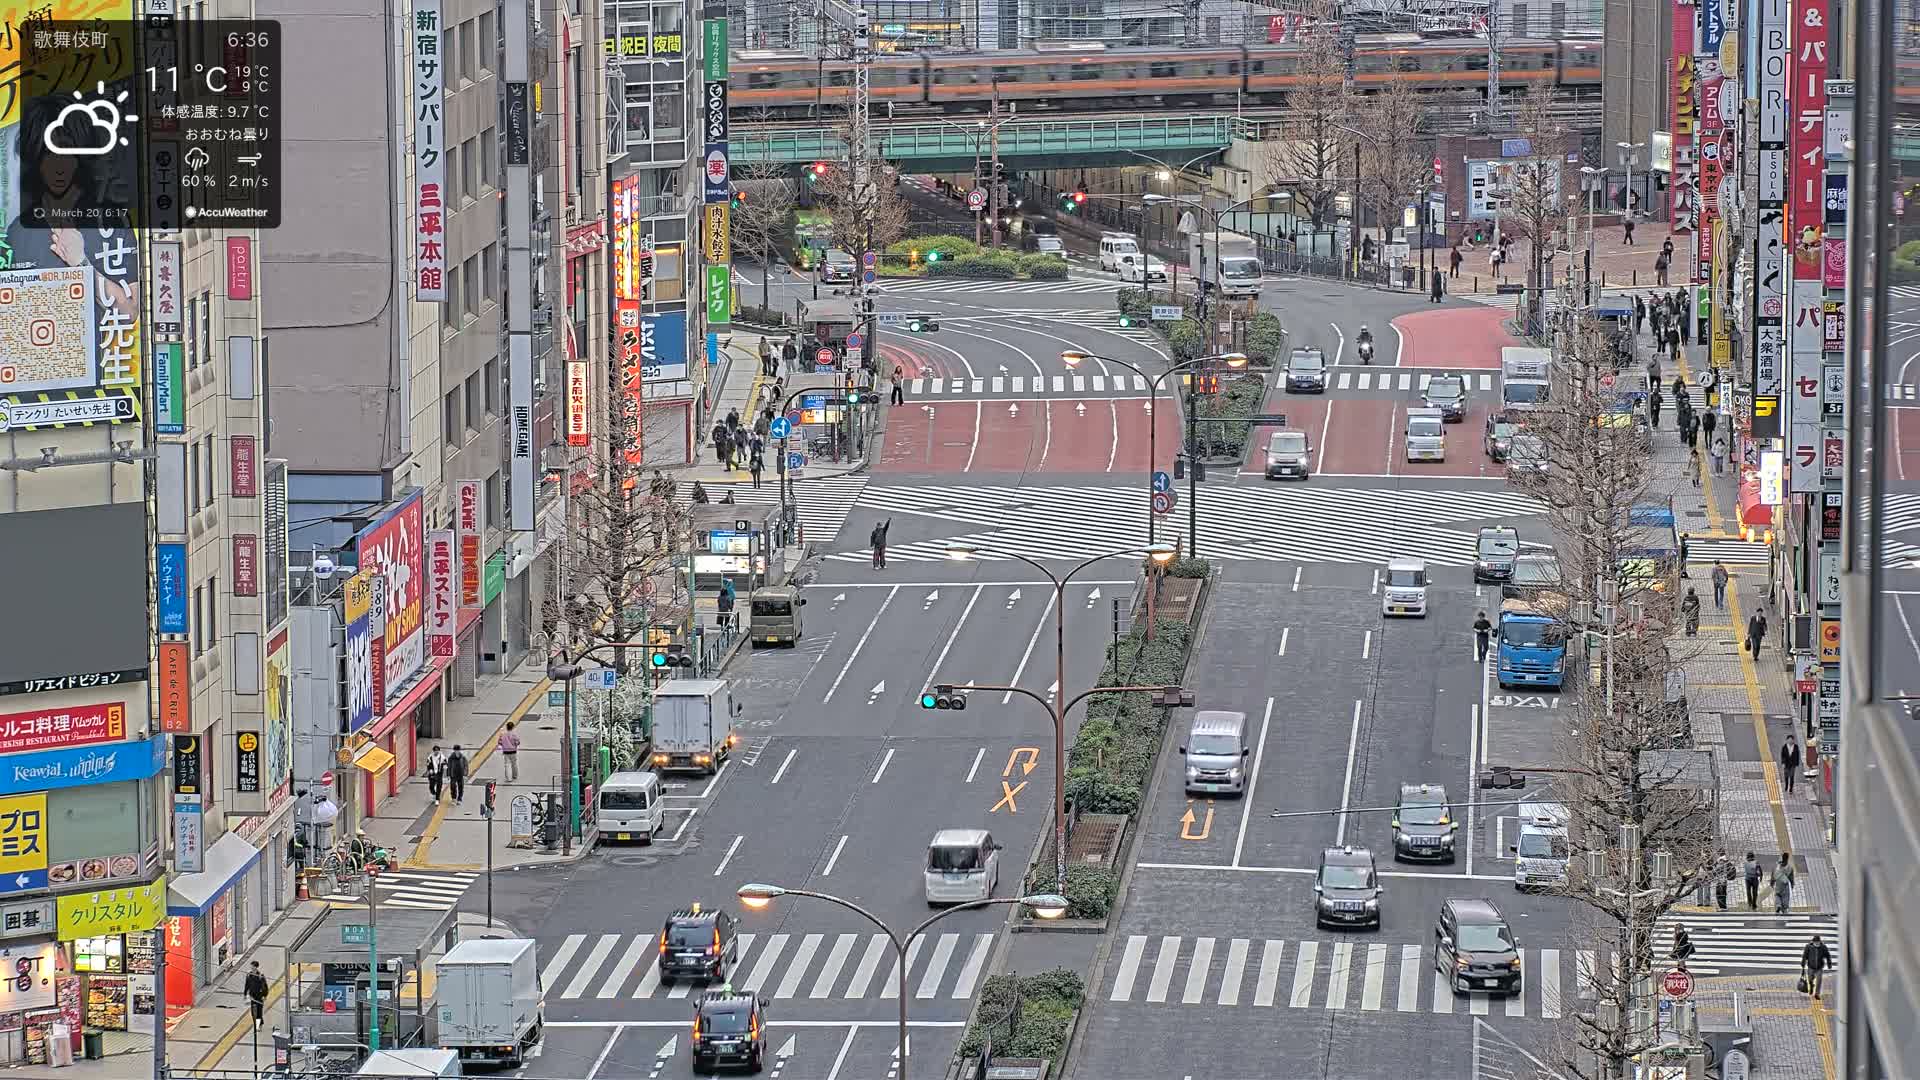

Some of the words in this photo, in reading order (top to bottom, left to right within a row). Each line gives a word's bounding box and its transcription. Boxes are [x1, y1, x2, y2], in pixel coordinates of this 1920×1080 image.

[621, 37, 646, 54] 祝日
[653, 35, 681, 53] 夜間
[416, 9, 440, 169] 新宿サンパーク
[709, 83, 723, 137] もつなべ
[1706, 86, 1717, 119] アコム
[709, 159, 725, 176] 薬
[1769, 152, 1777, 199] ESOLA
[418, 183, 443, 292] 三平本館
[711, 207, 724, 262] 肉汁水餃子
[1702, 227, 1710, 257] RESALE
[711, 274, 724, 312] レイク
[1825, 303, 1835, 311] 6F
[159, 323, 177, 332] 3F
[1760, 328, 1774, 381] 大衆酒場
[157, 352, 169, 414] FamilyMart
[1795, 306, 1821, 468] パセラ
[14, 406, 49, 420] テンクリ
[54, 403, 112, 418] たいせい先生
[1829, 404, 1842, 413] 5F
[515, 406, 529, 459] HOMEGAME
[461, 485, 473, 530] GAME
[1828, 496, 1840, 505] 3F
[162, 553, 174, 605] ゲウチャイ
[433, 541, 450, 628] 三平ストア
[375, 579, 383, 618] 389
[433, 635, 444, 643] B1
[441, 647, 452, 655] B2
[169, 648, 178, 676] CAFE
[25, 675, 77, 692] リアエイド
[80, 672, 121, 687] ビジョン
[169, 692, 178, 718] CRIE
[110, 709, 121, 735] 5F
[25, 734, 70, 746] RESTAURANT
[1, 809, 41, 832] プロ
[1, 834, 41, 858] ミス
[5, 909, 41, 930] 囲碁
[71, 902, 143, 926] クリスタル
[327, 990, 343, 1002] 12
